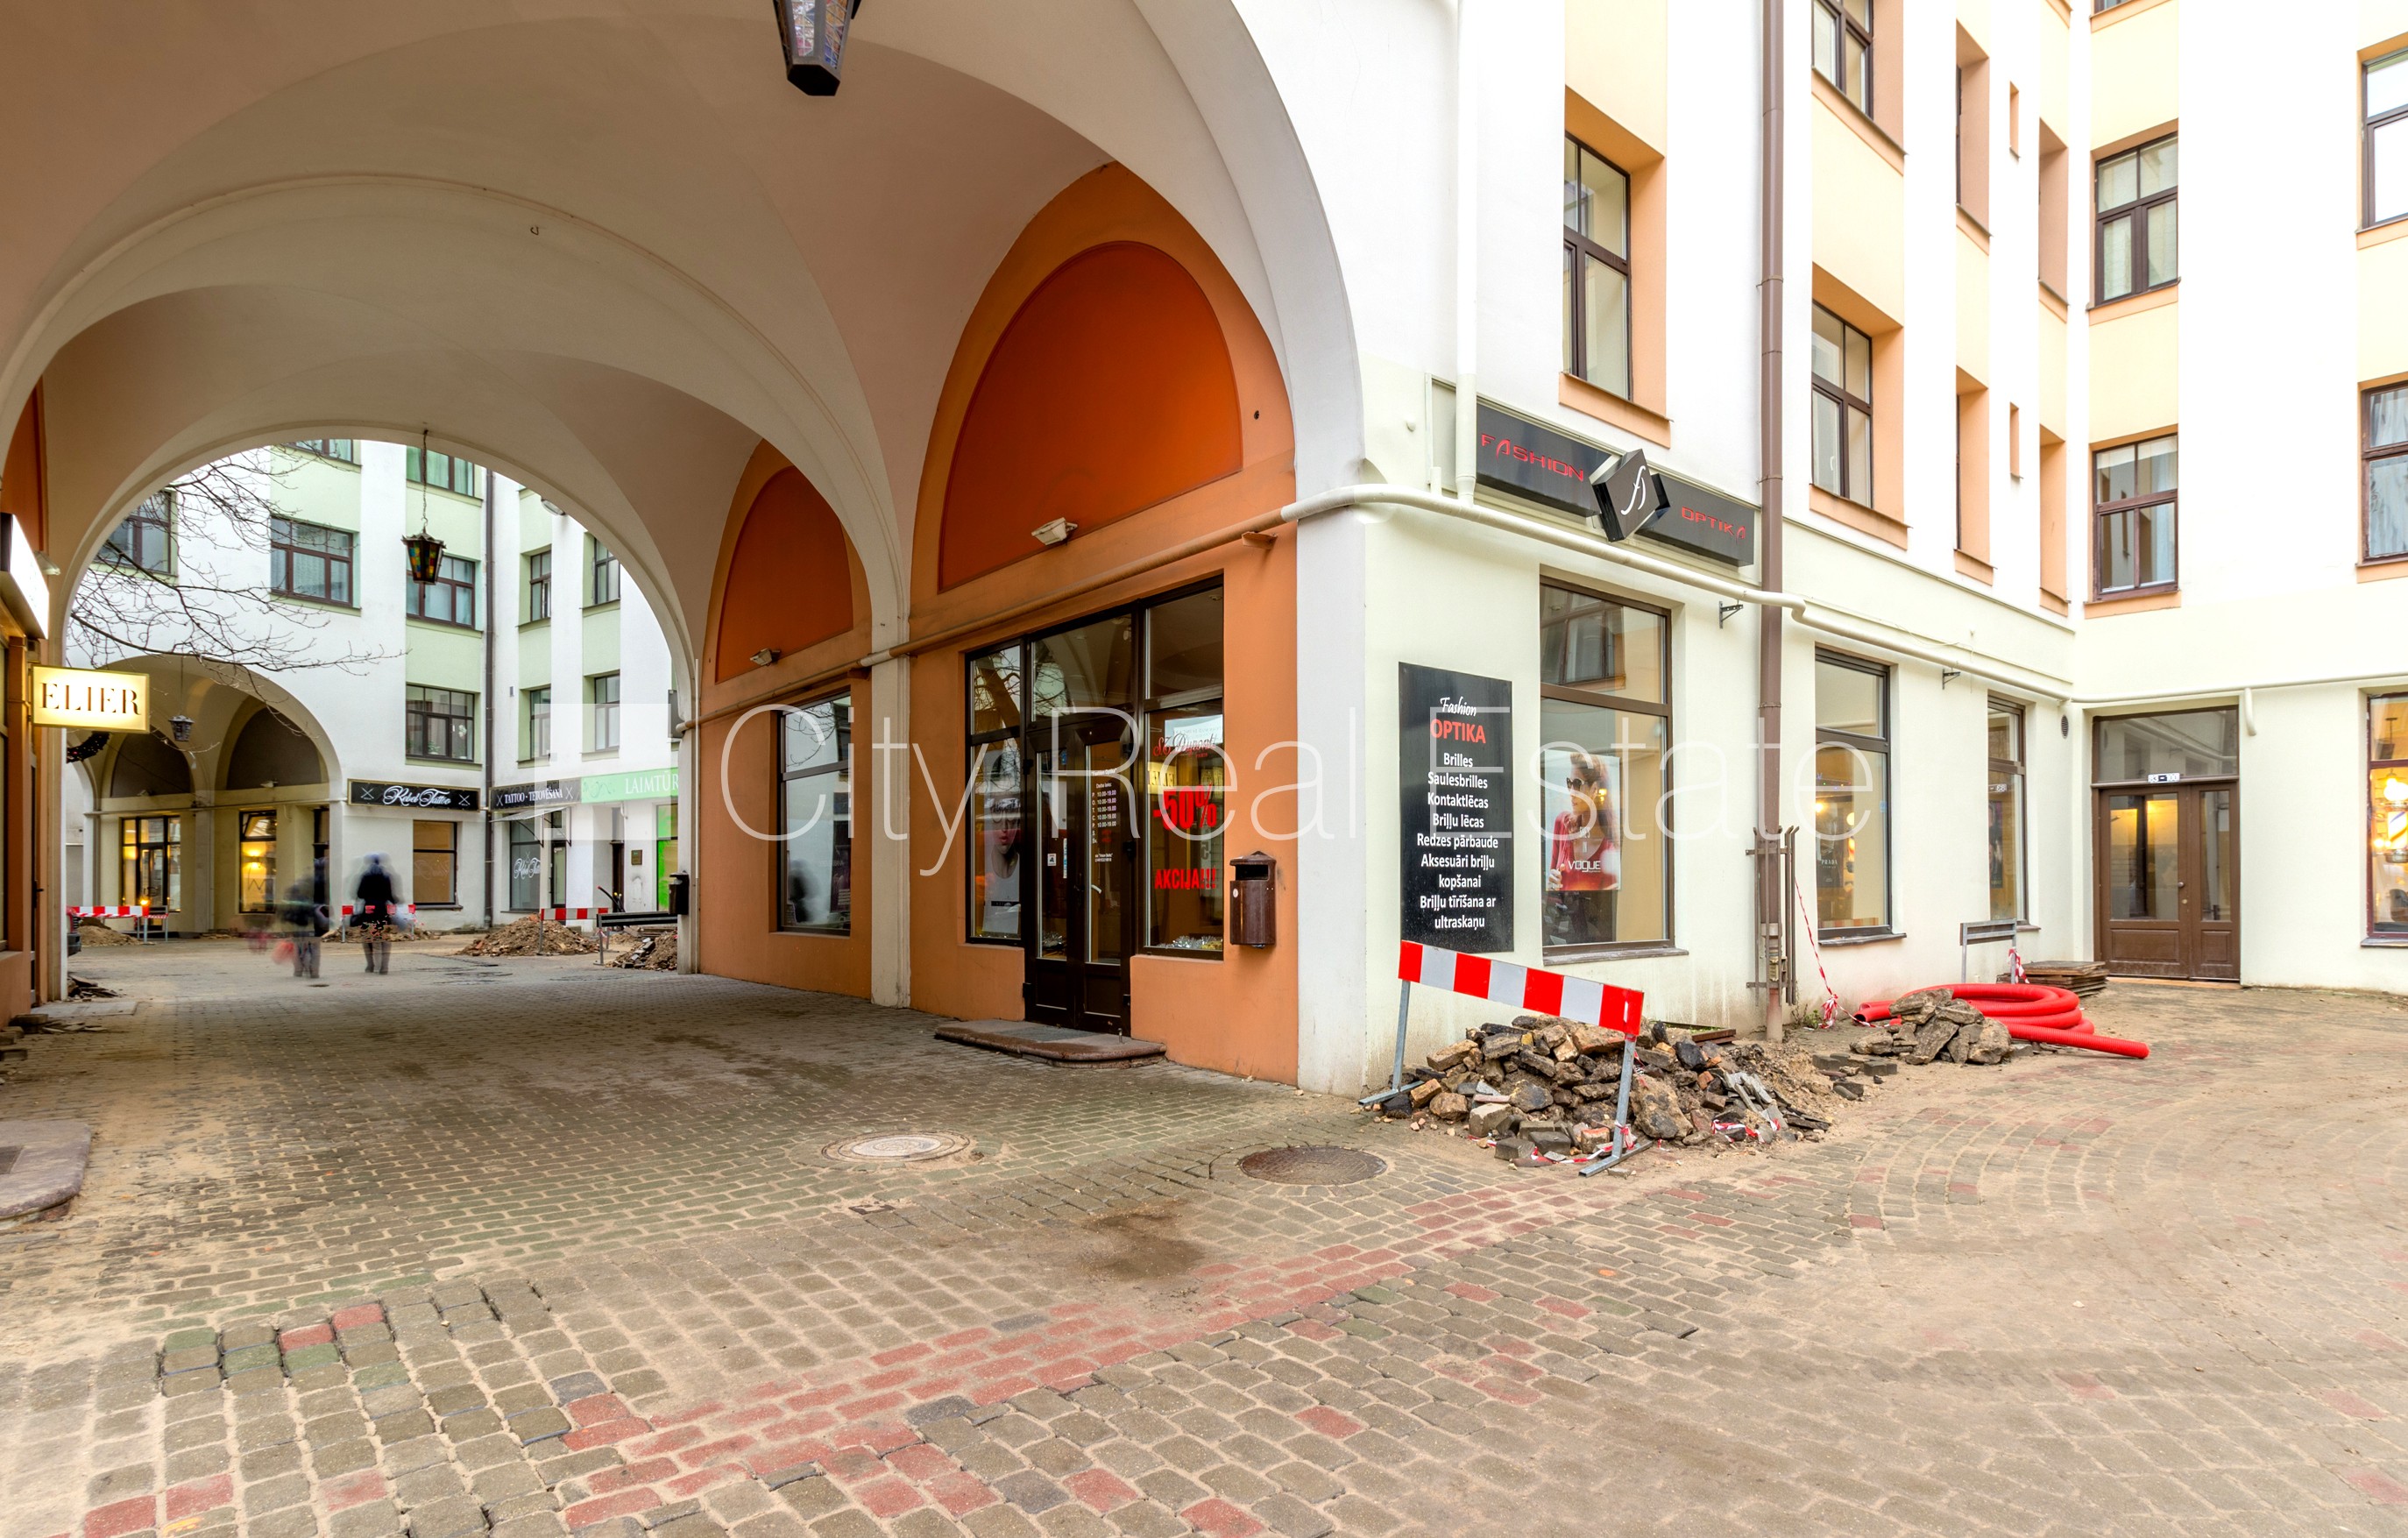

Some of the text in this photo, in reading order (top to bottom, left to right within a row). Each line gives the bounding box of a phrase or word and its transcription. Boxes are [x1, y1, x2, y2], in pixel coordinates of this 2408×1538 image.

[1481, 433, 1583, 482] FASHION
[1682, 506, 1746, 544] OPTIKA
[40, 683, 141, 715] ELIER
[1440, 696, 1477, 717] Fashion
[1430, 719, 1486, 744] OPTIKA
[1443, 753, 1473, 768] Brilles
[1427, 771, 1488, 789] Saulesbrilles
[383, 785, 452, 807] Rebel Tattoo
[505, 792, 526, 804] TATTOO
[1427, 792, 1489, 808] Kontaktlēcas
[1152, 782, 1217, 831] -50%
[1433, 813, 1484, 829] Briļļu lēcas
[1417, 833, 1498, 850] Redzes pārbaude
[1420, 854, 1495, 871] Aksesuāri briļļu
[1154, 868, 1217, 890] AKCIJA!!!
[1439, 874, 1482, 891] kopšanai
[1420, 894, 1497, 911] Briļļu tīrīšana ar
[1434, 914, 1485, 931] ultraskaņu
